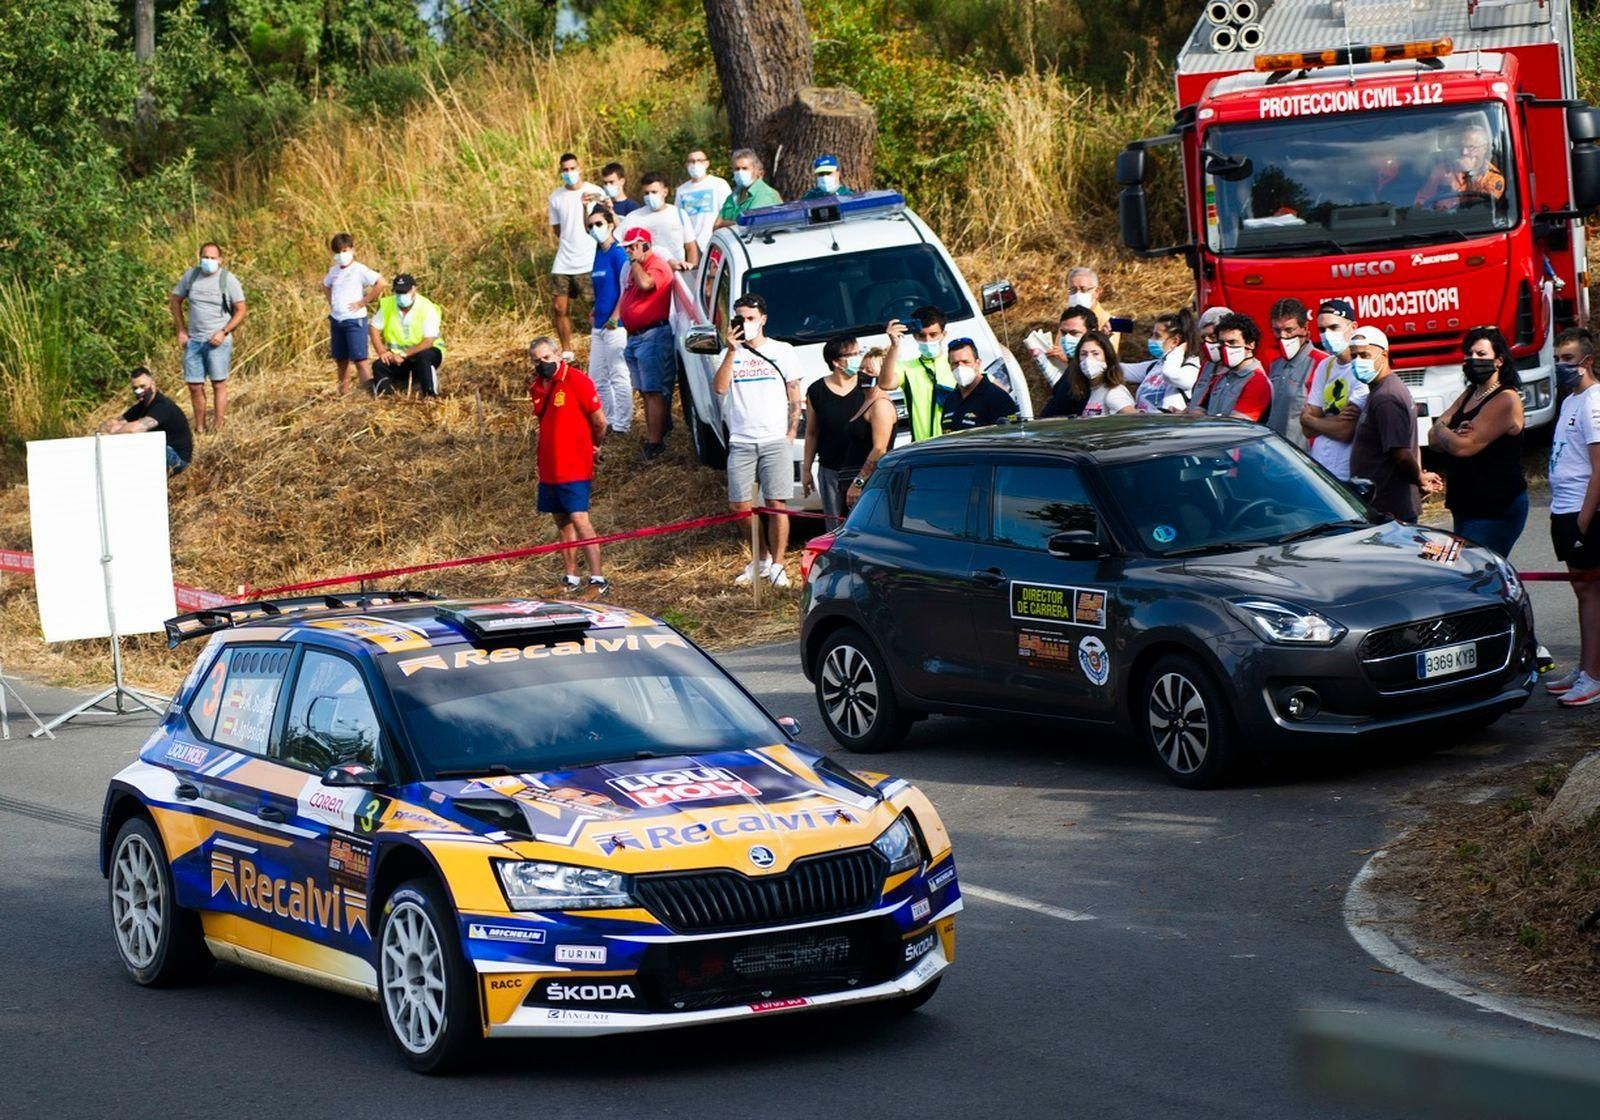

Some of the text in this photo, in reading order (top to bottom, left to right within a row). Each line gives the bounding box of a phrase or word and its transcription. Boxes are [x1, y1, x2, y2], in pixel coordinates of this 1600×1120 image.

[1260, 90, 1359, 118] PROTECCION
[1362, 86, 1402, 109] CIVIL
[1331, 260, 1395, 278] IVECO
[743, 358, 765, 367] new
[1022, 587, 1064, 604] DIRECTOR
[1017, 600, 1029, 614] DE
[1030, 602, 1069, 618] CARRERA
[454, 634, 639, 669] Recalvi
[1426, 649, 1476, 673] 9369 KYB
[203, 662, 226, 718] 3
[616, 767, 734, 792] LIQUI
[632, 781, 743, 806] MOLY
[360, 799, 380, 832] 3
[646, 810, 816, 849] Recalvi
[239, 859, 341, 932] Recalvi
[489, 928, 542, 940] MICHELIN
[561, 949, 602, 960] TURINI
[491, 979, 522, 989] RACC
[546, 982, 636, 1001] ŠKODA
